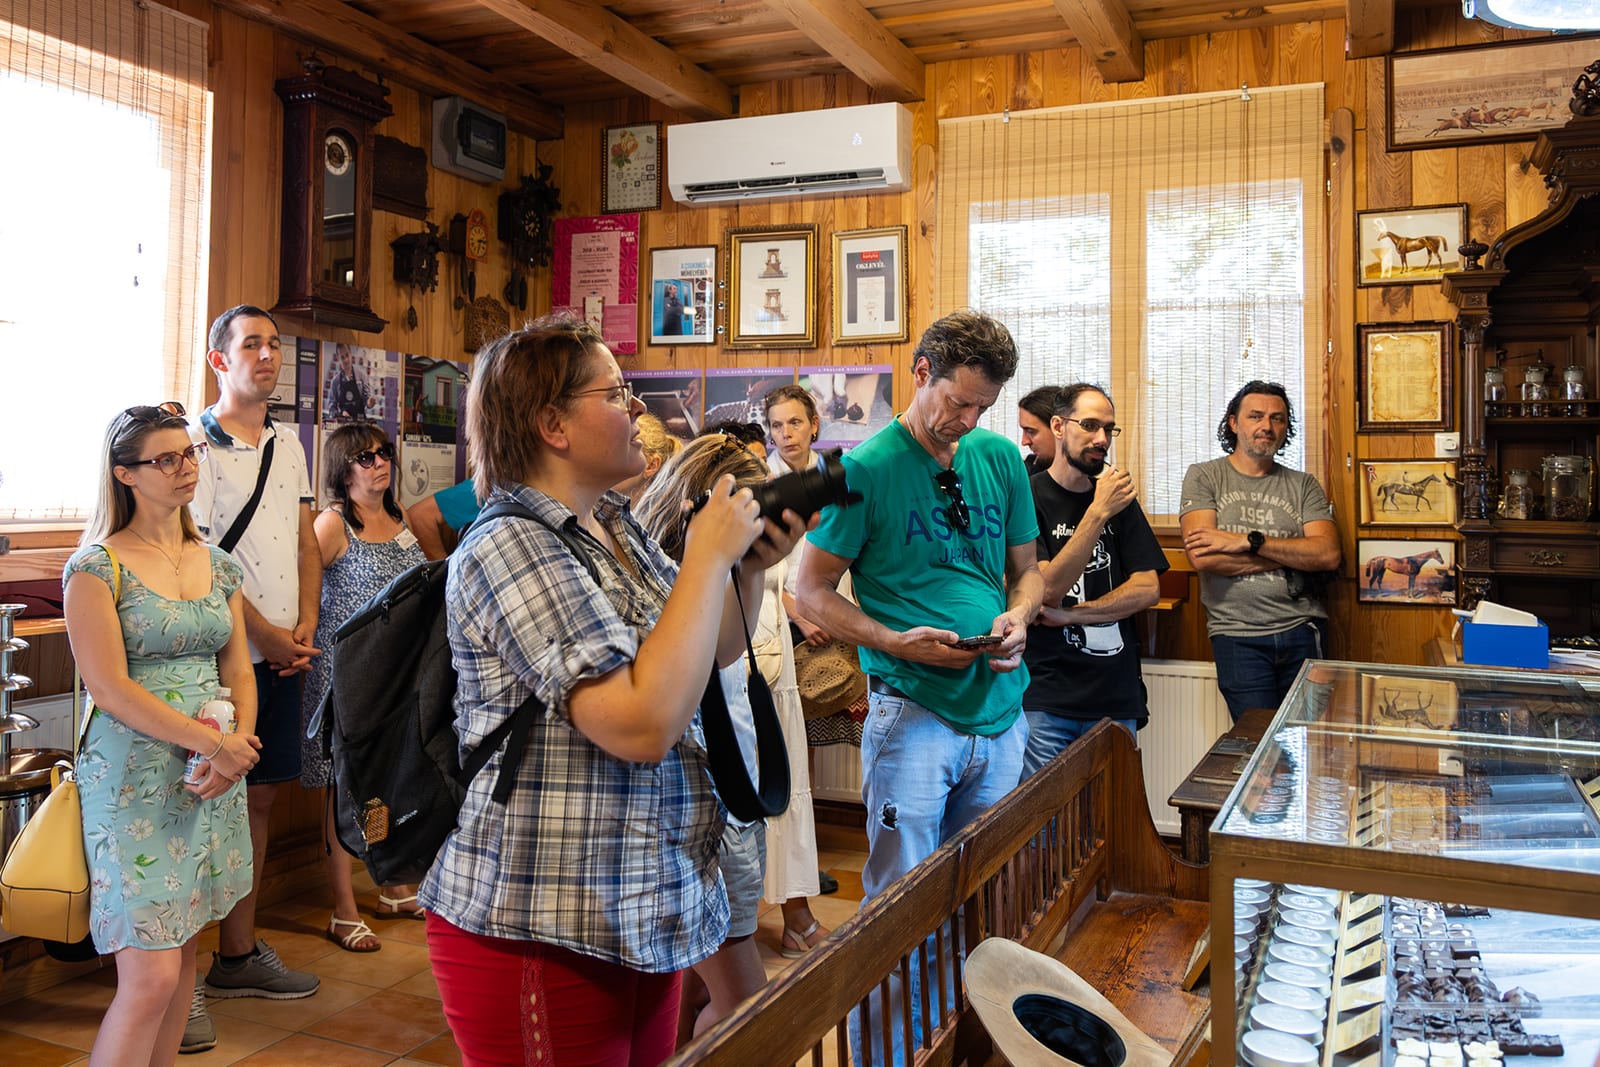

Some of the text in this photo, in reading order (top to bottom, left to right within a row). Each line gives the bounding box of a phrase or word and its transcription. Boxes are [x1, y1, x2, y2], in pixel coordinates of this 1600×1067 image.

[904, 502, 1003, 546] ASCS
[1239, 505, 1275, 525] 1954
[939, 546, 985, 564] JAPAN
